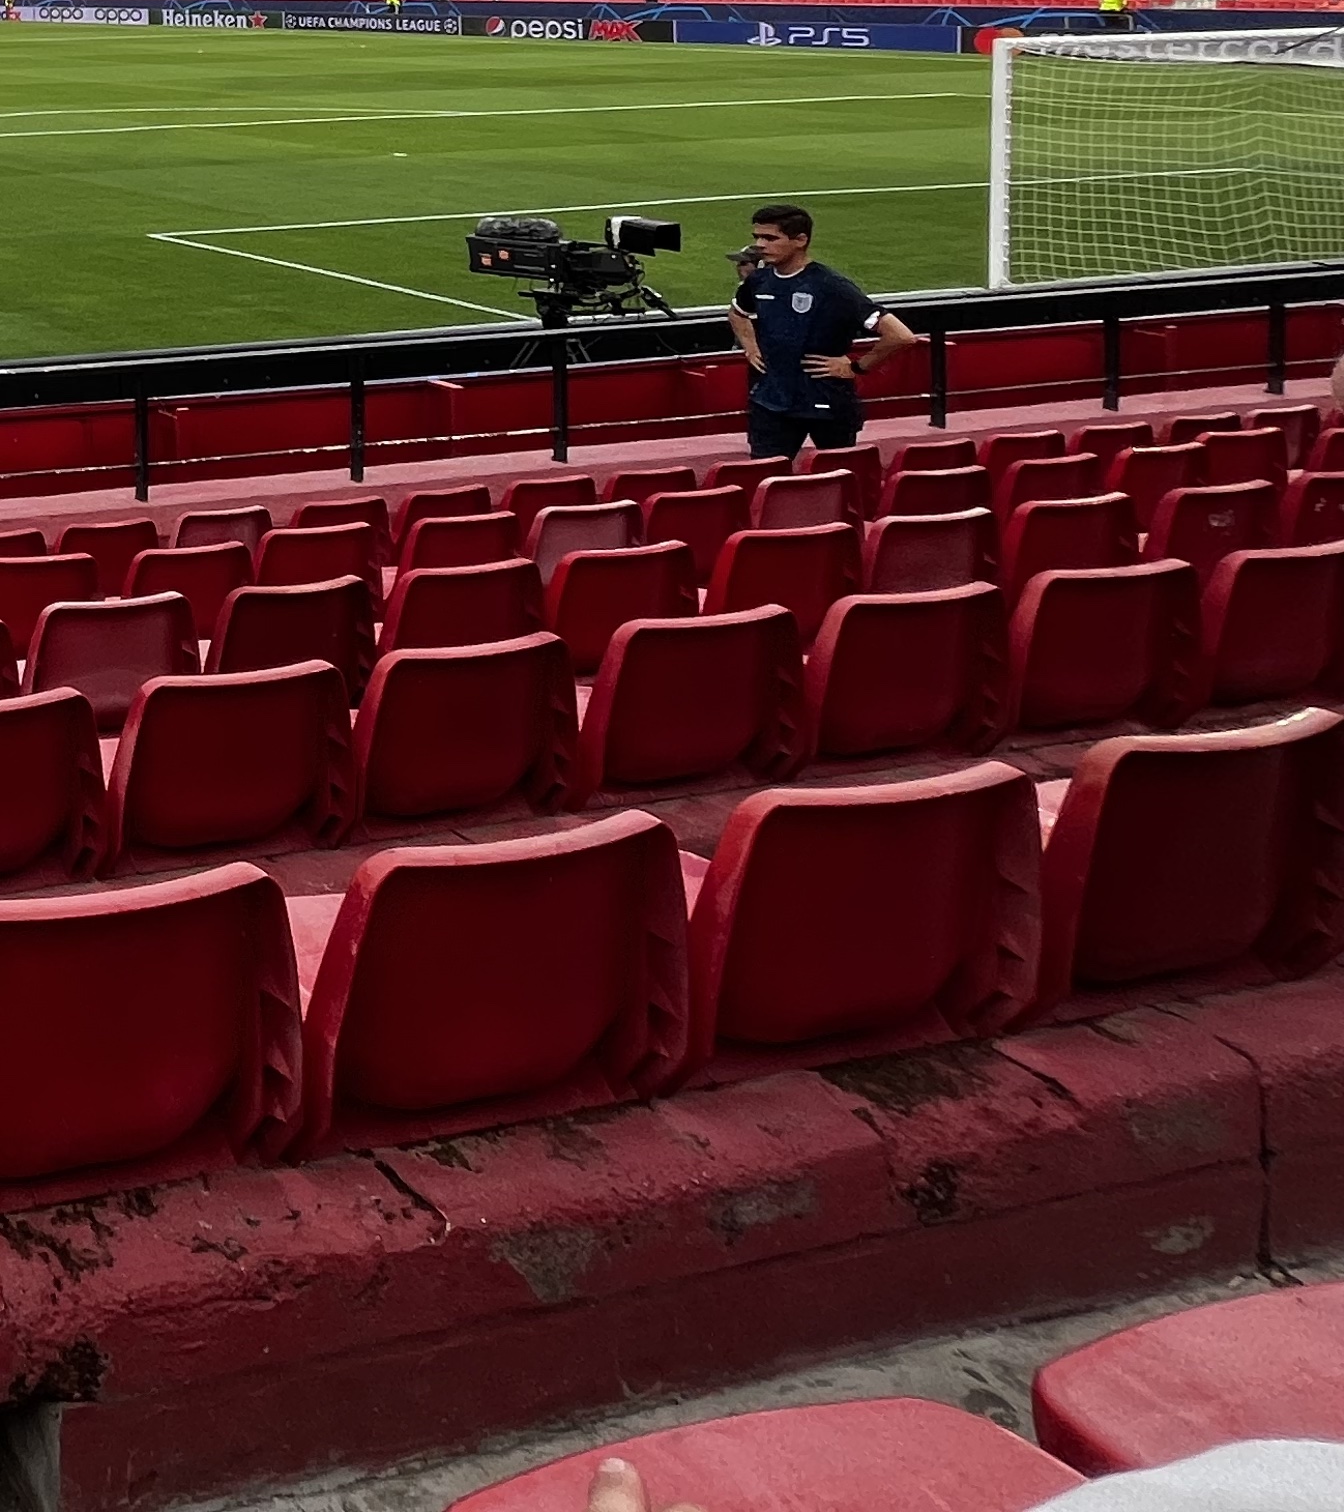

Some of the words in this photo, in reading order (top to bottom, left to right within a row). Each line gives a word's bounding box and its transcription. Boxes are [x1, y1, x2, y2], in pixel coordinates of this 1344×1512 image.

[39, 7, 84, 22] oppo
[94, 8, 143, 25] oppo
[161, 9, 248, 29] Heineken
[298, 16, 325, 28] UEFA
[327, 16, 393, 31] CHAMPIONS
[395, 18, 441, 33] LEAGUE
[512, 18, 584, 40] pepsi
[589, 19, 644, 43] MAX
[788, 26, 872, 48] PS5
